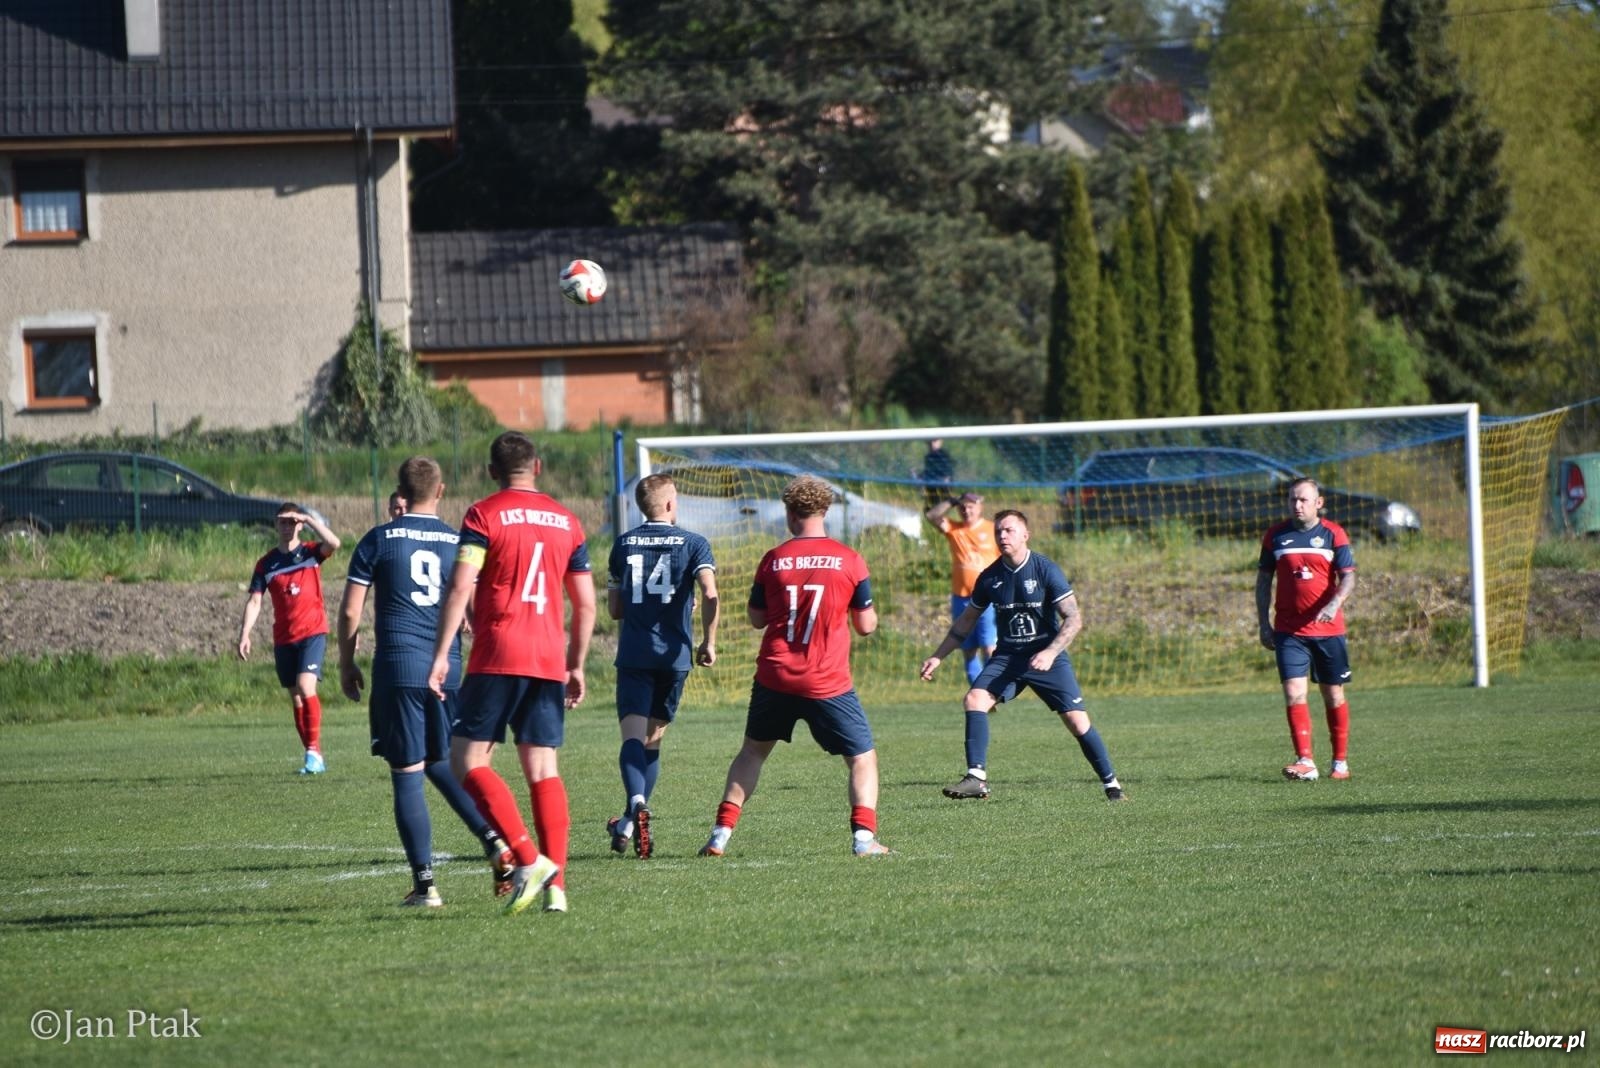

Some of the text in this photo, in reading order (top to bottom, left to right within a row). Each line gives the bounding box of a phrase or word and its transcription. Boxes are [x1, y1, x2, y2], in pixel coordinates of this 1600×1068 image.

[385, 527, 407, 539] LKS
[499, 508, 525, 526] LKS
[410, 550, 441, 607] 9
[521, 542, 547, 615] 4
[626, 553, 676, 604] 14
[795, 555, 843, 571] BRZEZIE
[785, 584, 825, 645] 17
